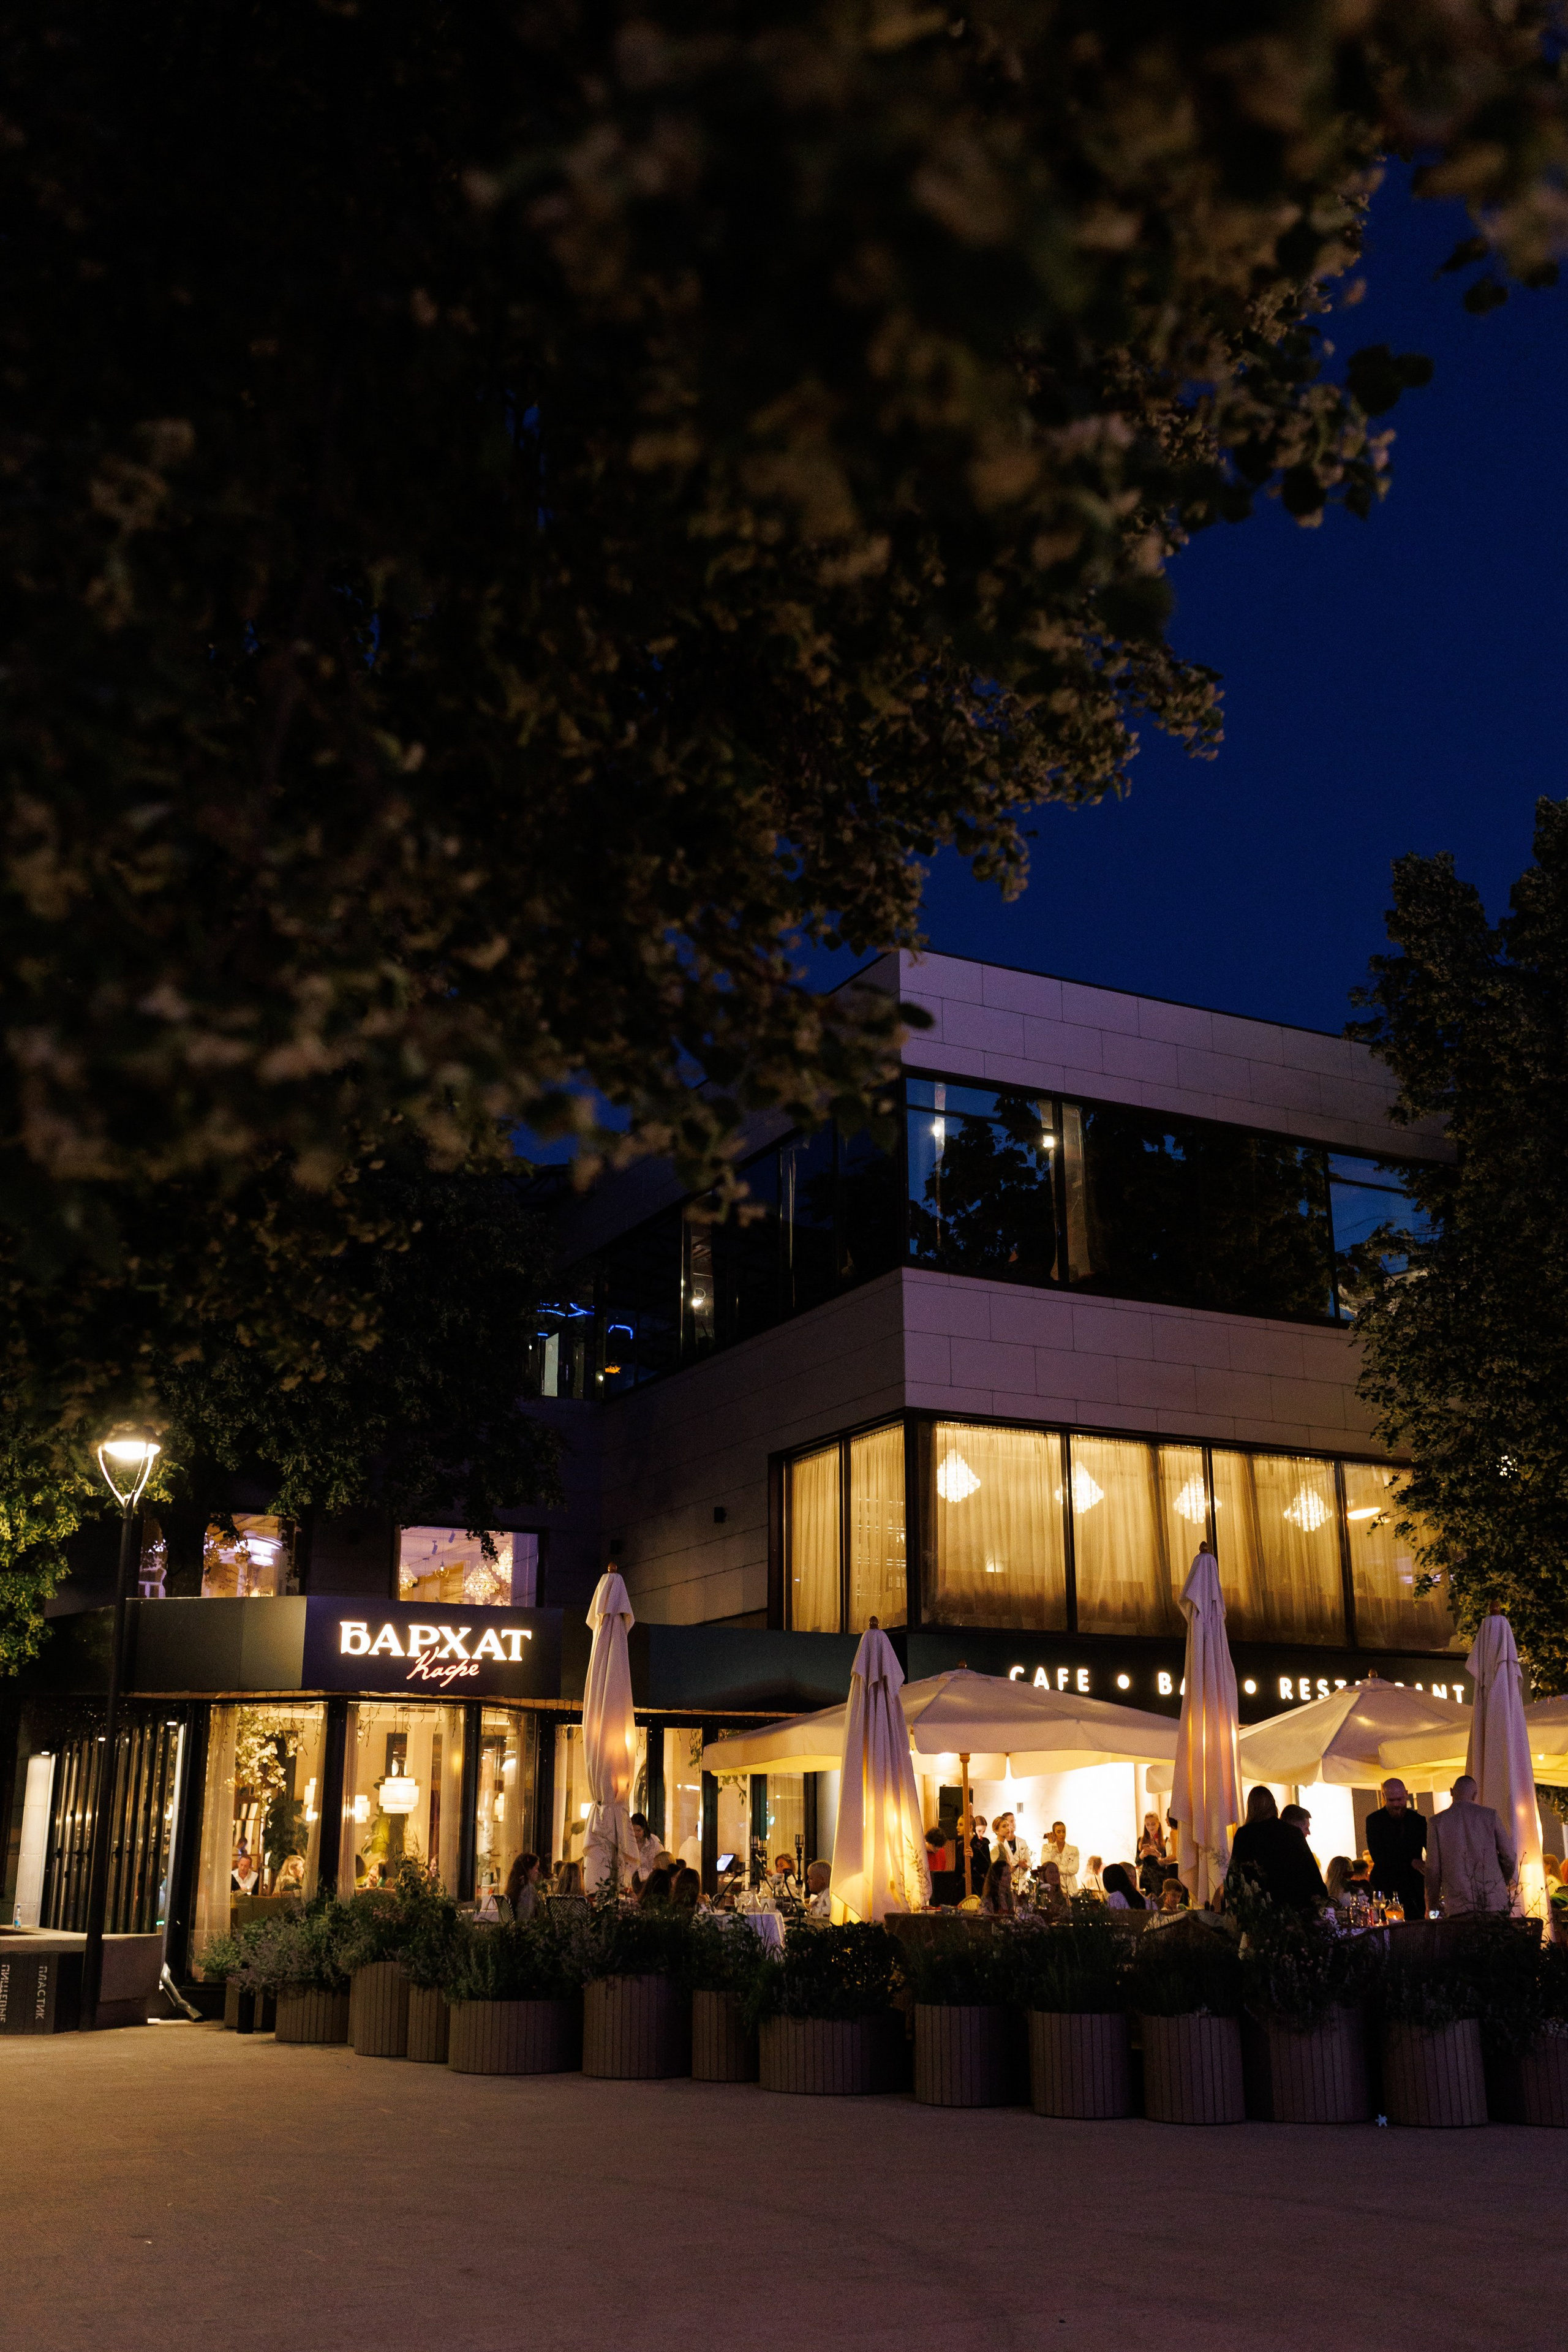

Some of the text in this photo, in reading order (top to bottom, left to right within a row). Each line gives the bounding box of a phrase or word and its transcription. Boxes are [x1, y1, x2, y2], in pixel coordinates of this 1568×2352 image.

[339, 1621, 532, 1662] БАРХАТ
[405, 1646, 480, 1687] Кафе
[1009, 1665, 1465, 1704] CAFE RESTNT
[35, 1966, 48, 2020] ПЛАСТИК
